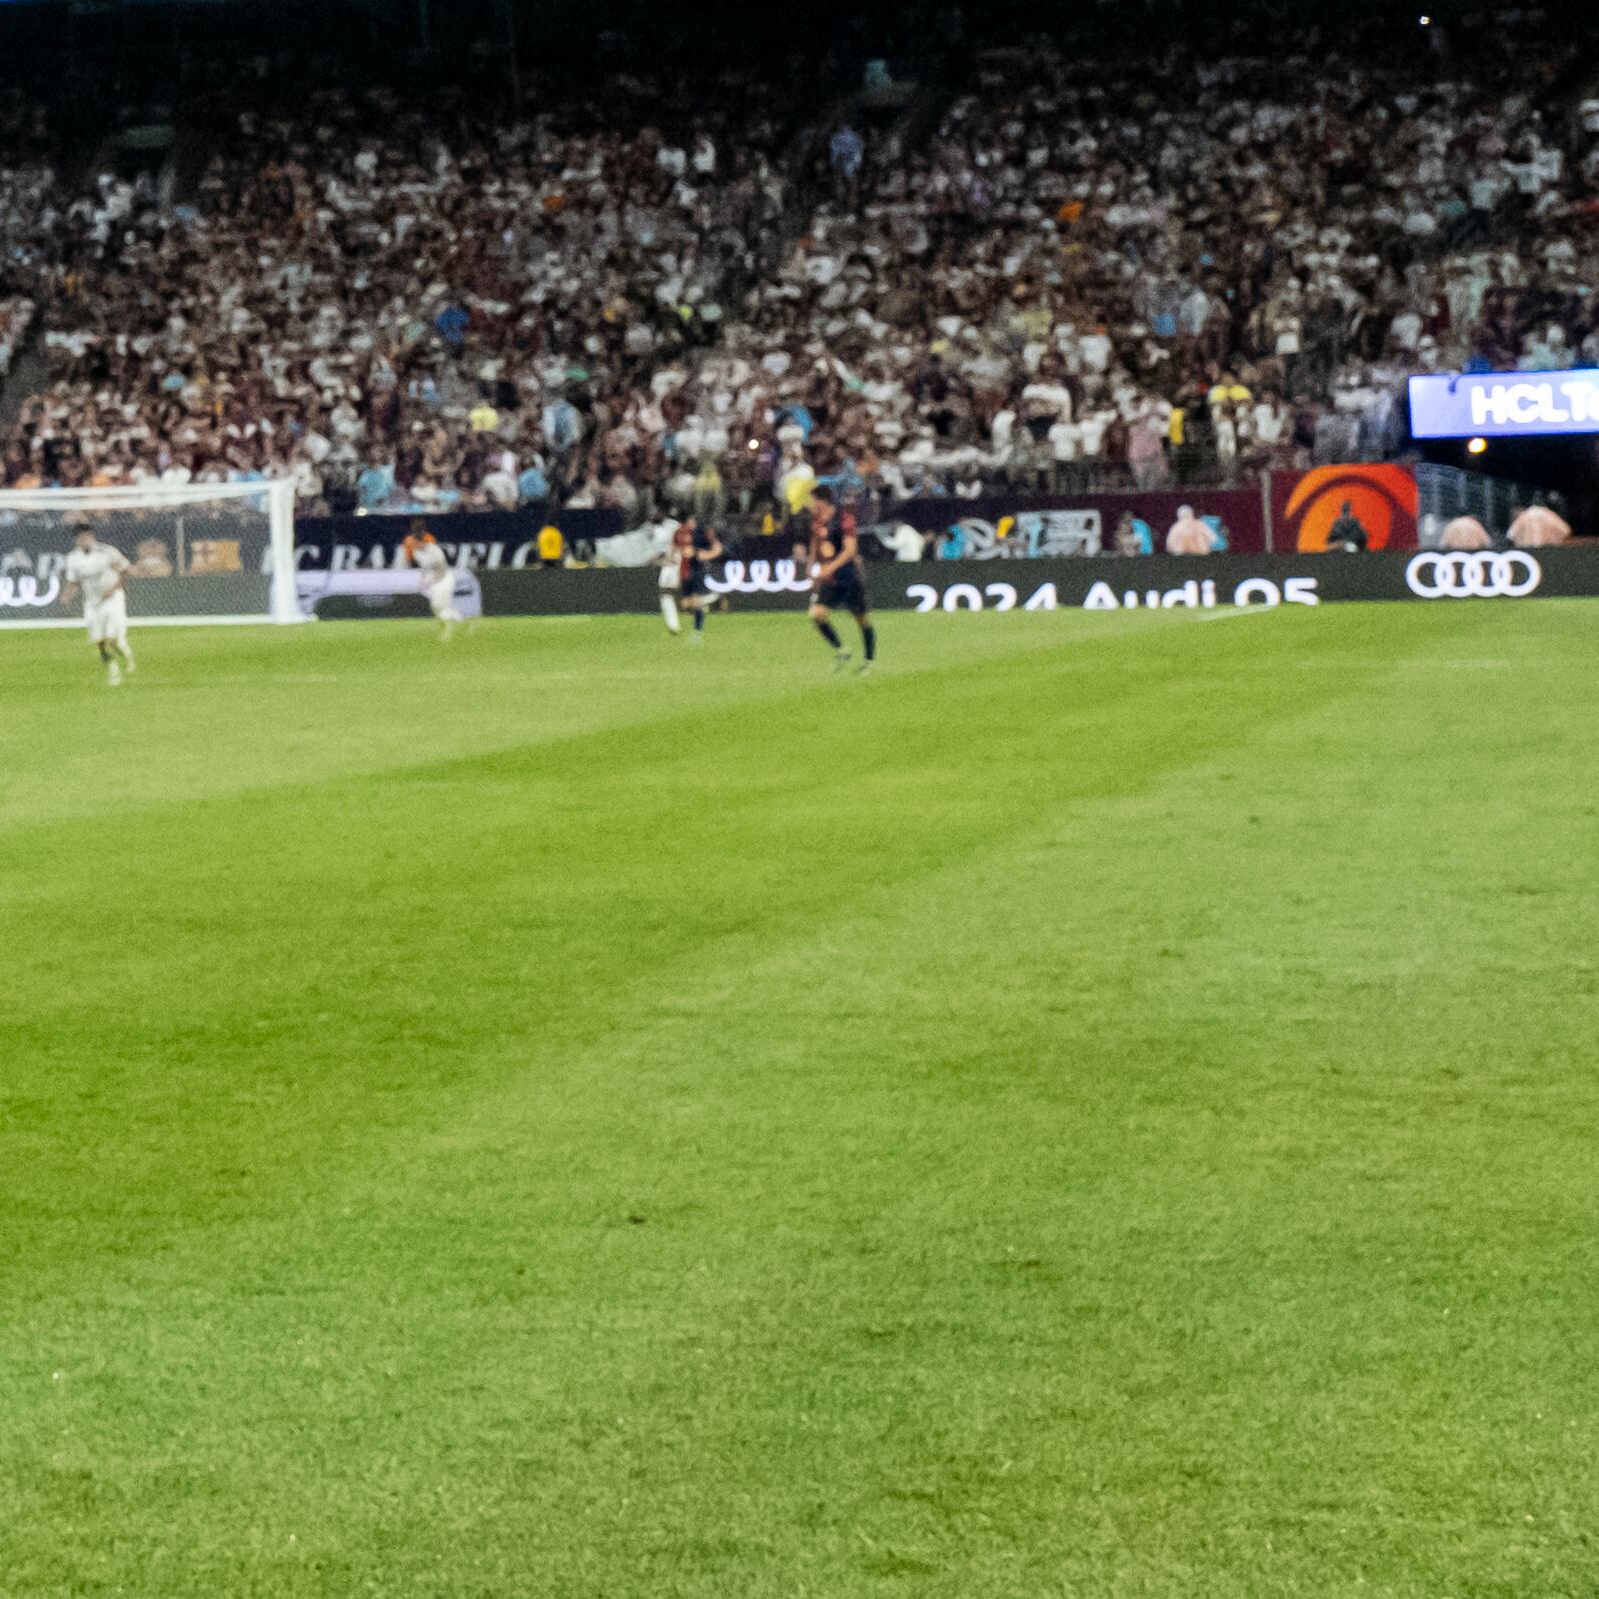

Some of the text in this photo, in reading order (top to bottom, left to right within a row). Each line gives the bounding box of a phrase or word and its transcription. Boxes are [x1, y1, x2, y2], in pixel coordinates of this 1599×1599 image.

[1472, 382, 1599, 426] HCLT
[906, 581, 1057, 613] 2024
[1082, 579, 1216, 610] Audi
